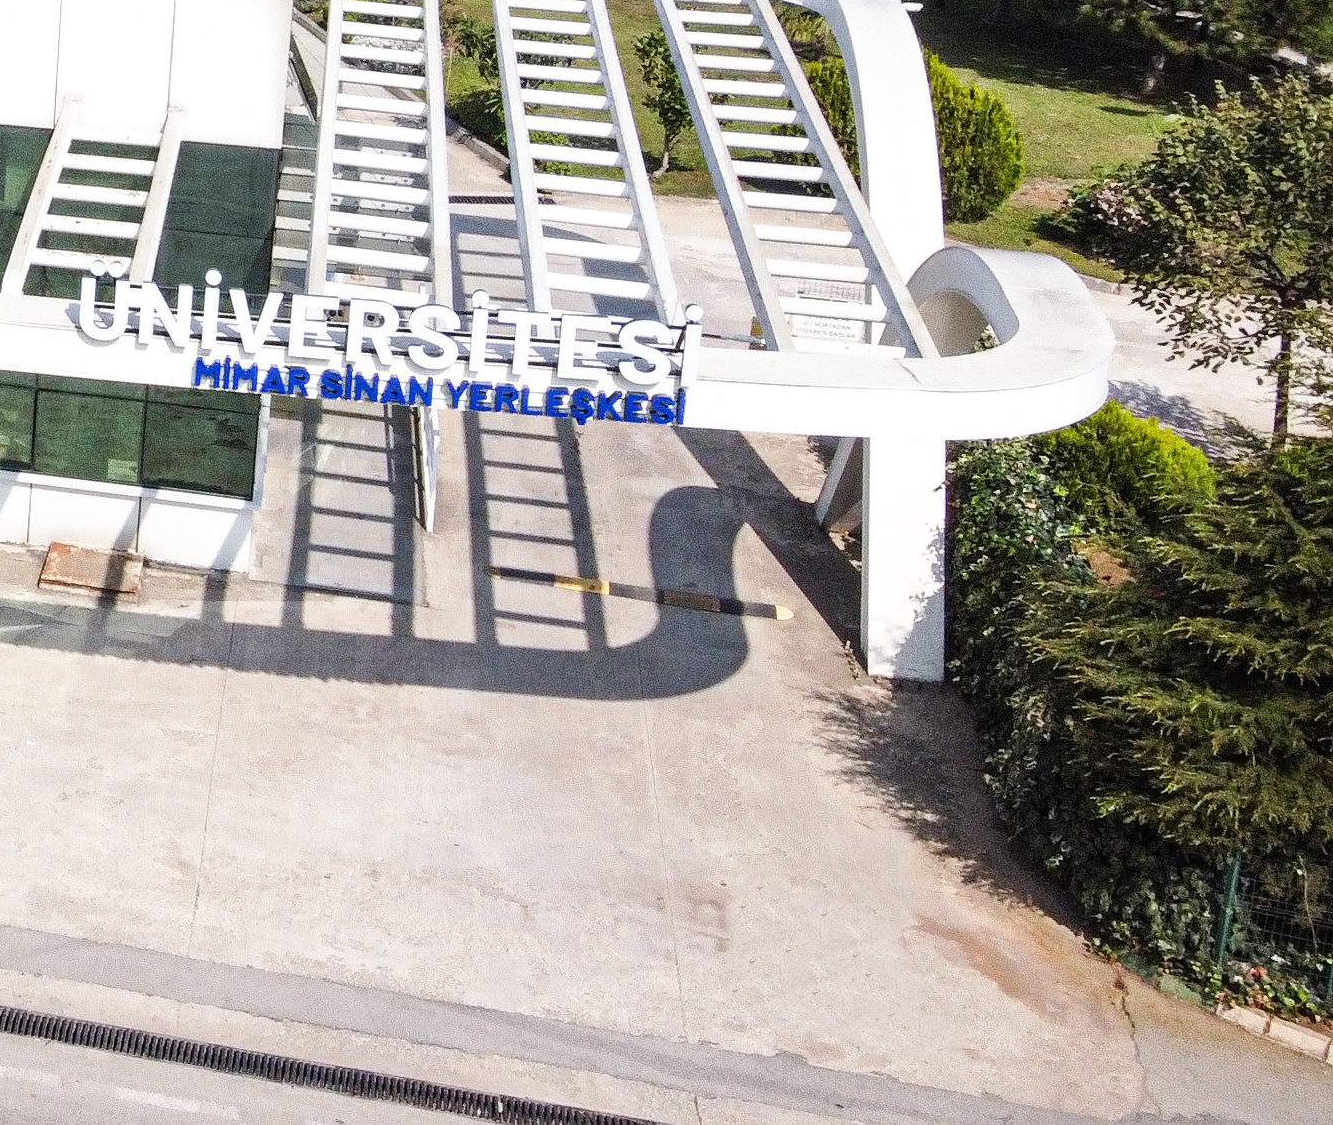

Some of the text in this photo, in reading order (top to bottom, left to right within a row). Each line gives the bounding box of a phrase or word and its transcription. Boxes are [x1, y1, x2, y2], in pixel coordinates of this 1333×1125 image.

[79, 259, 704, 389] ÜNİVERSİTESİ
[195, 355, 687, 425] MİMAR SİNAN YERLEŞKESİ
